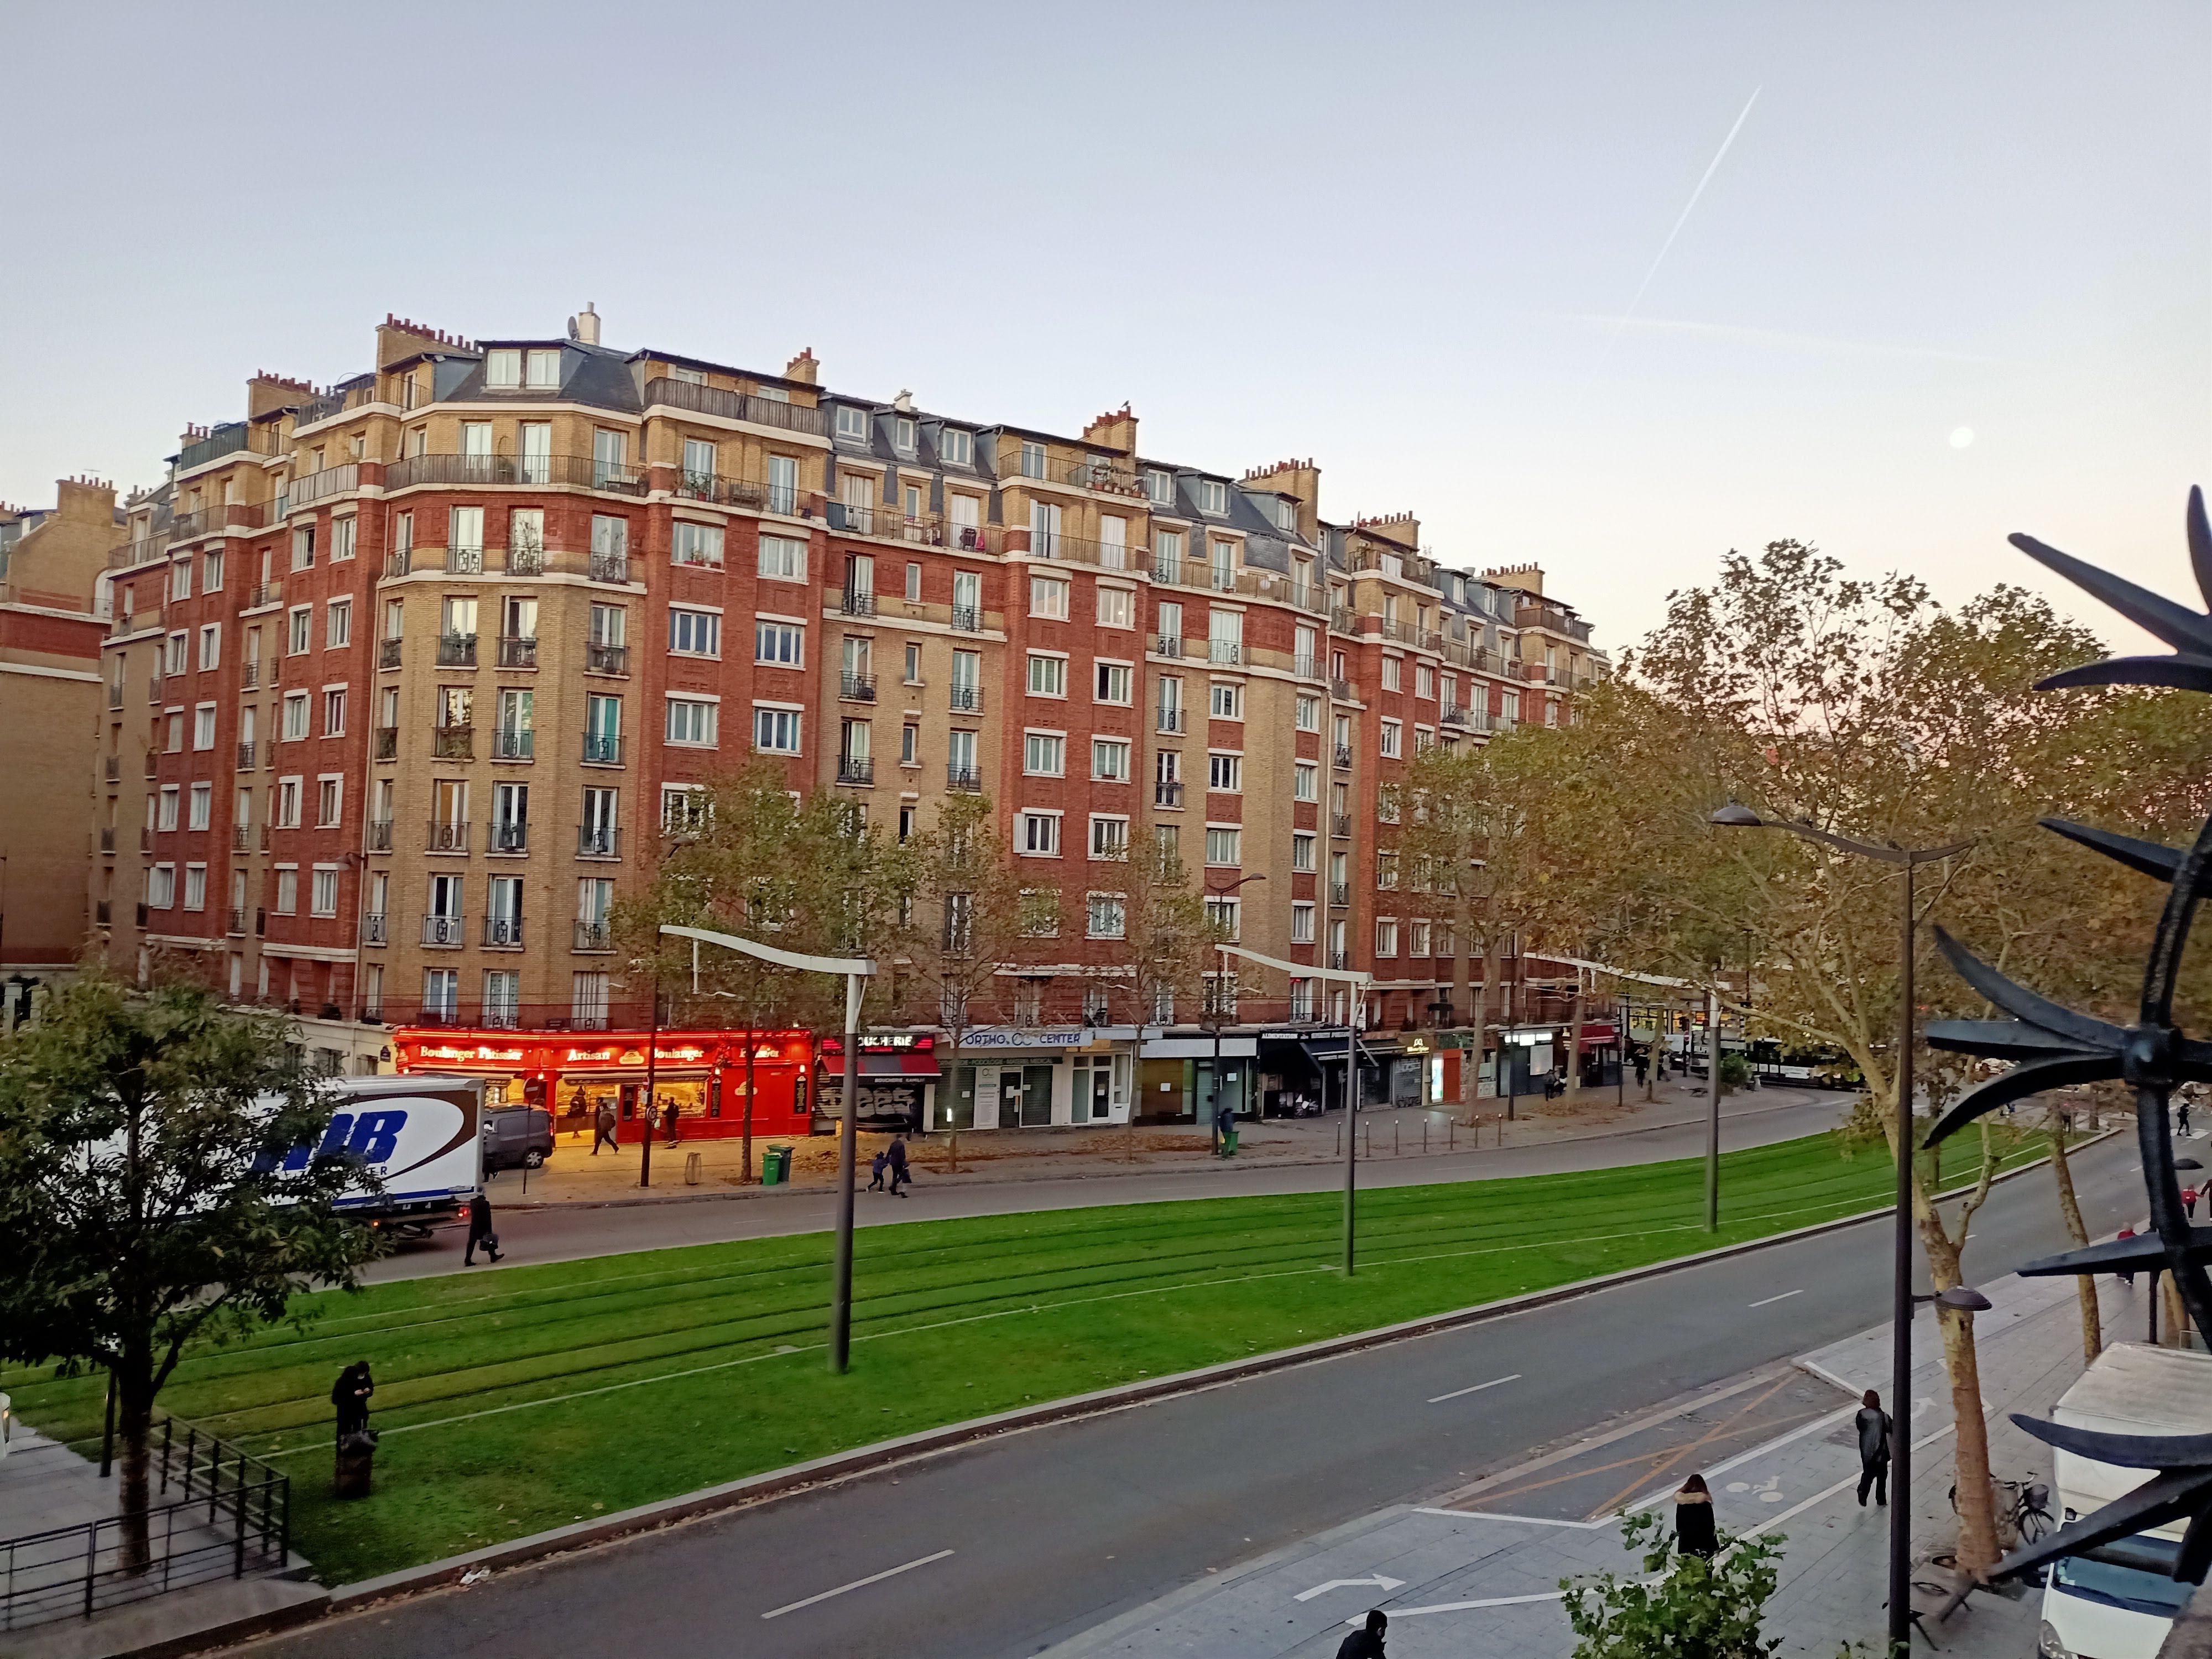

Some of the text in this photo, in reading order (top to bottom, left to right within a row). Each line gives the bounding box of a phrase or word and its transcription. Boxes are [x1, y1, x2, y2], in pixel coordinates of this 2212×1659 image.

[858, 1036, 912, 1046] OUCHERIE
[1040, 1033, 1081, 1044] CENTER
[420, 1046, 475, 1062] Boulanger
[567, 1049, 611, 1061] Artisan
